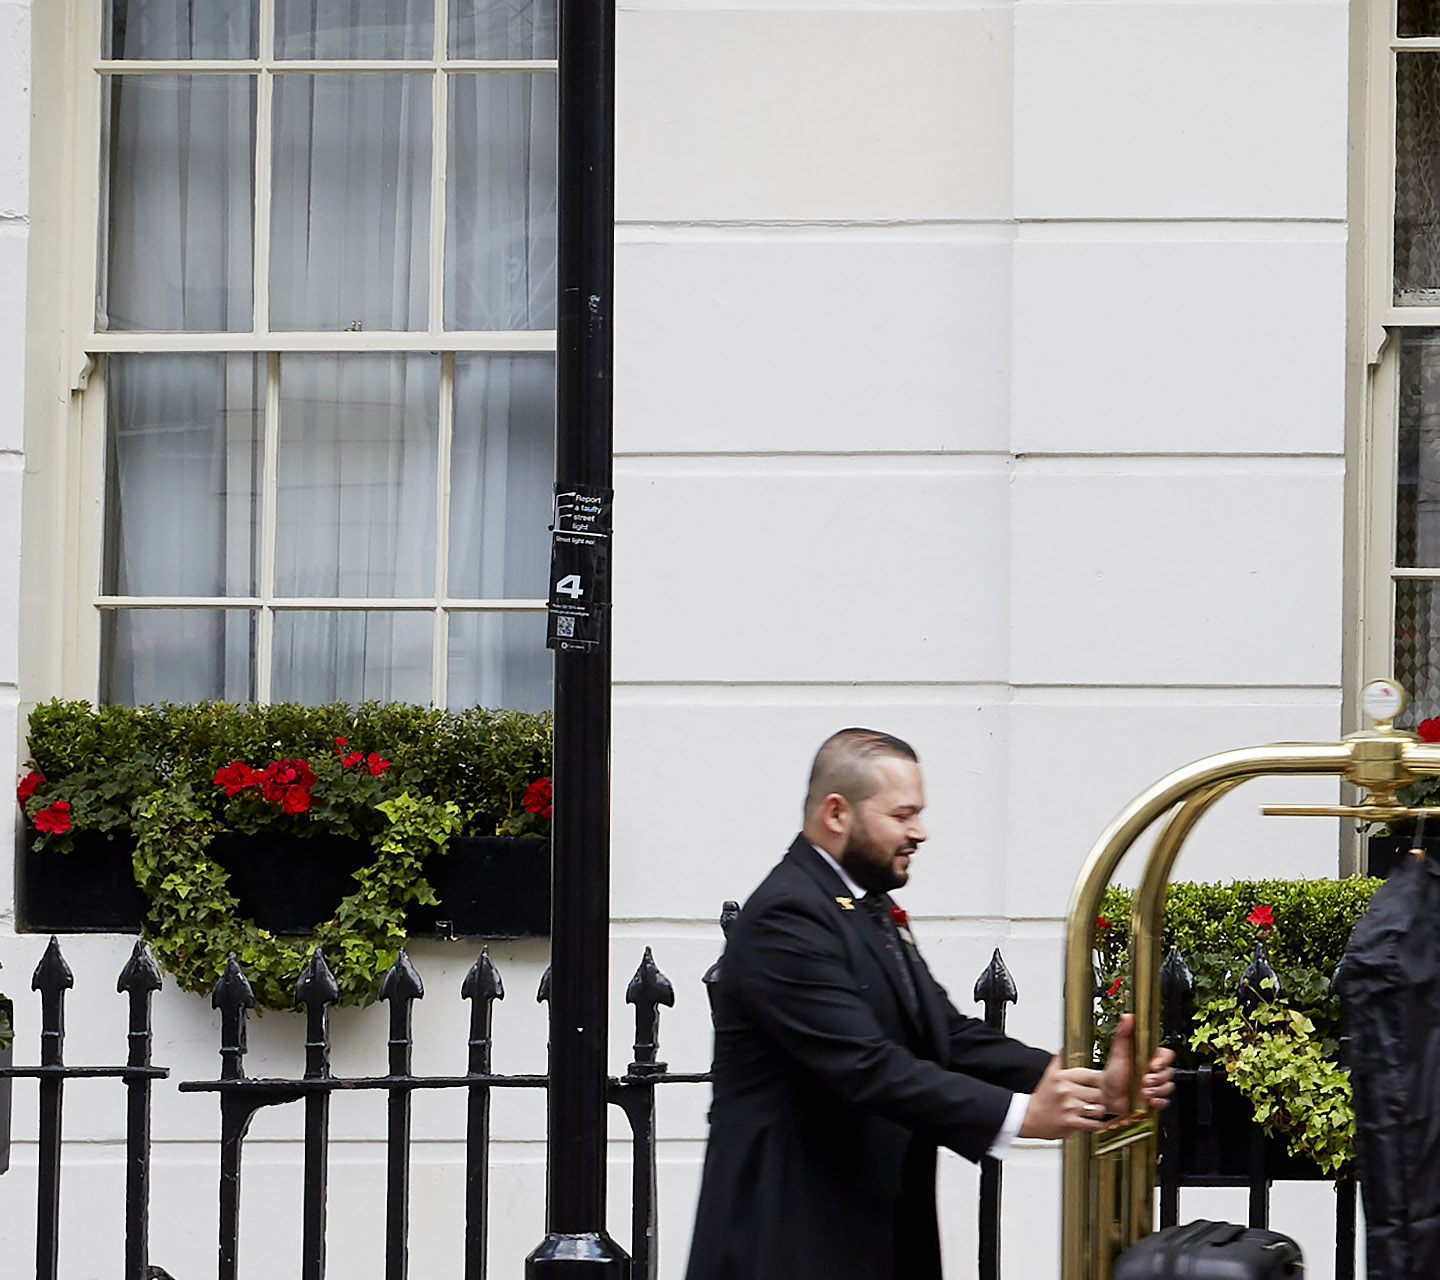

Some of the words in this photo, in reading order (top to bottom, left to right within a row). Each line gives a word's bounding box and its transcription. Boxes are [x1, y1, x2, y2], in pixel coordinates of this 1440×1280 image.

[575, 494, 601, 505] Report
[573, 514, 595, 522] street
[556, 574, 584, 599] 4
